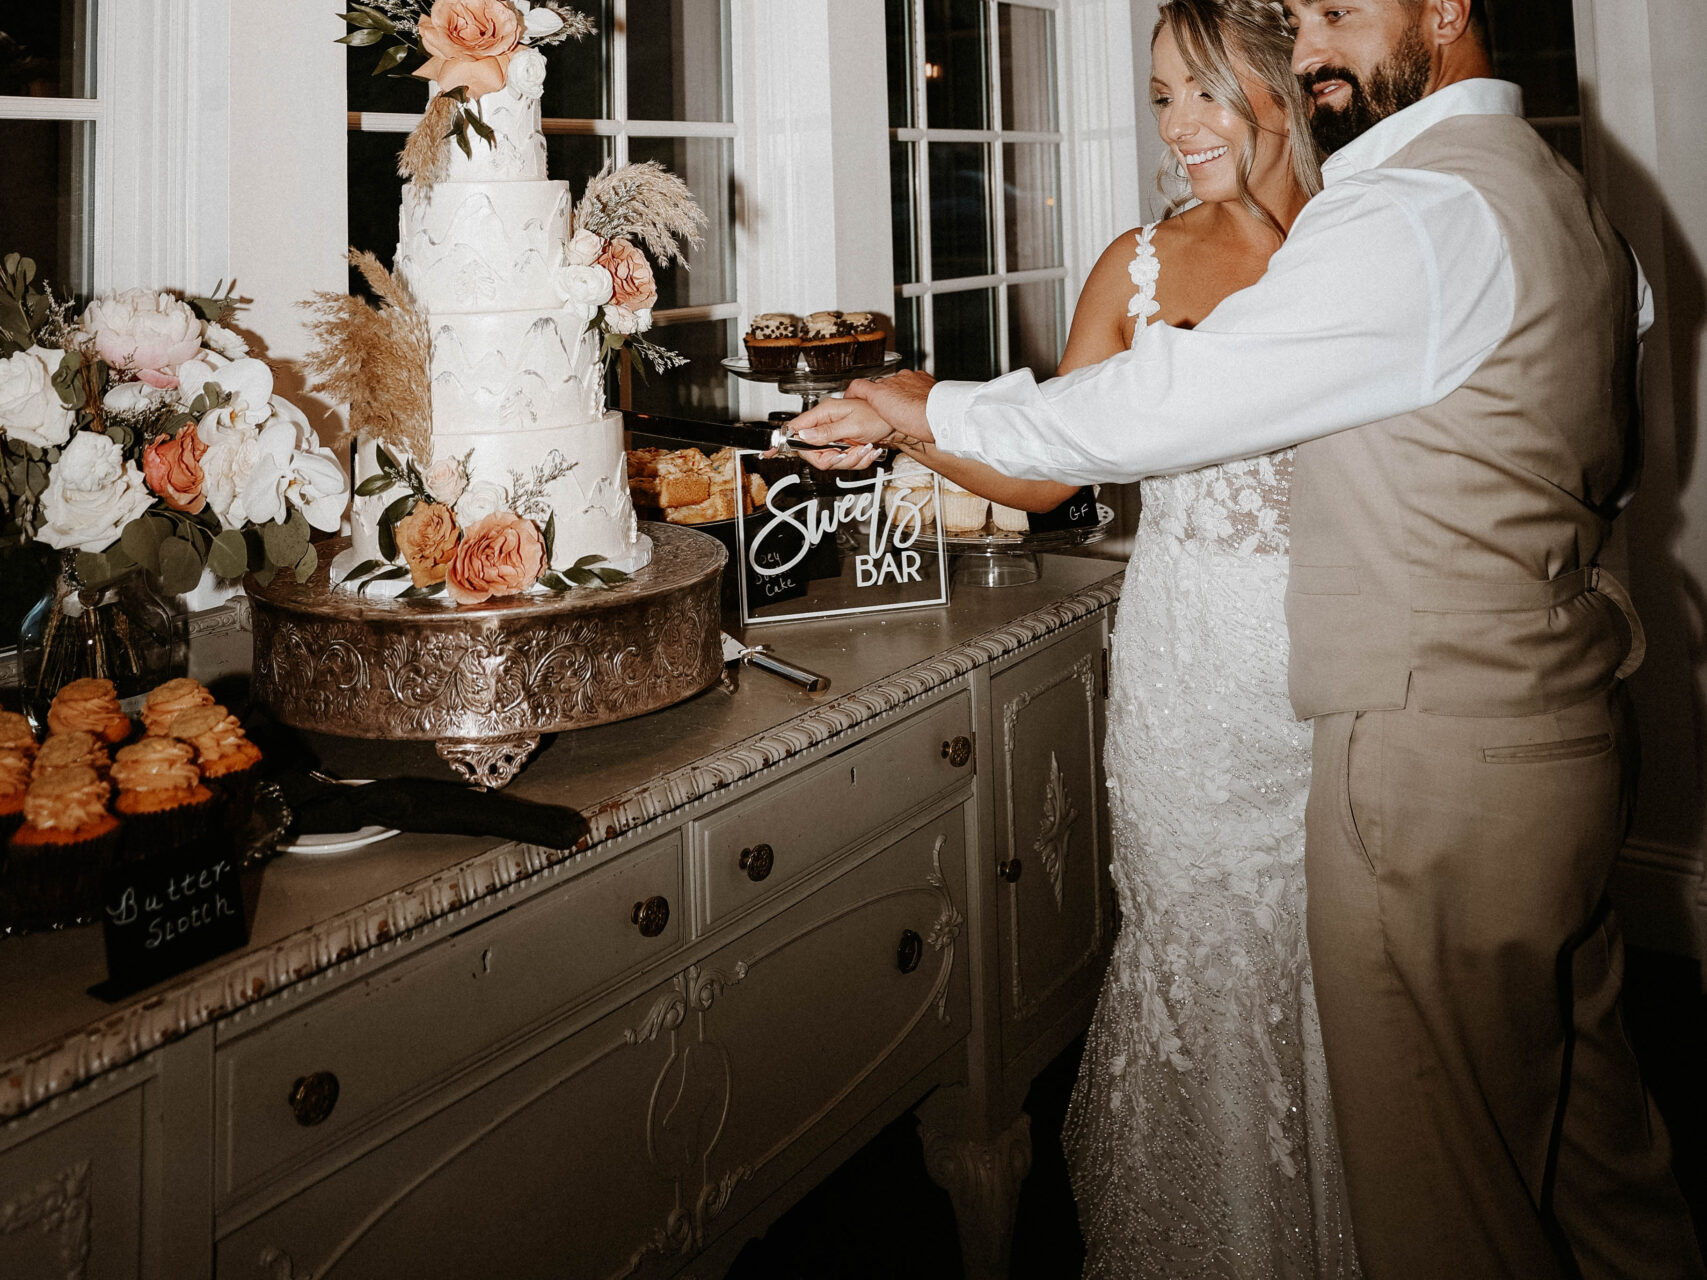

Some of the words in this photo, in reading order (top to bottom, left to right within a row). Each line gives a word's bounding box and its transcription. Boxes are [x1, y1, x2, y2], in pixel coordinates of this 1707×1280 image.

[749, 467, 934, 576] Sweets
[1069, 503, 1089, 521] GF
[765, 576, 796, 597] Cake
[855, 550, 923, 588] BAR
[145, 893, 236, 949] Scotch
